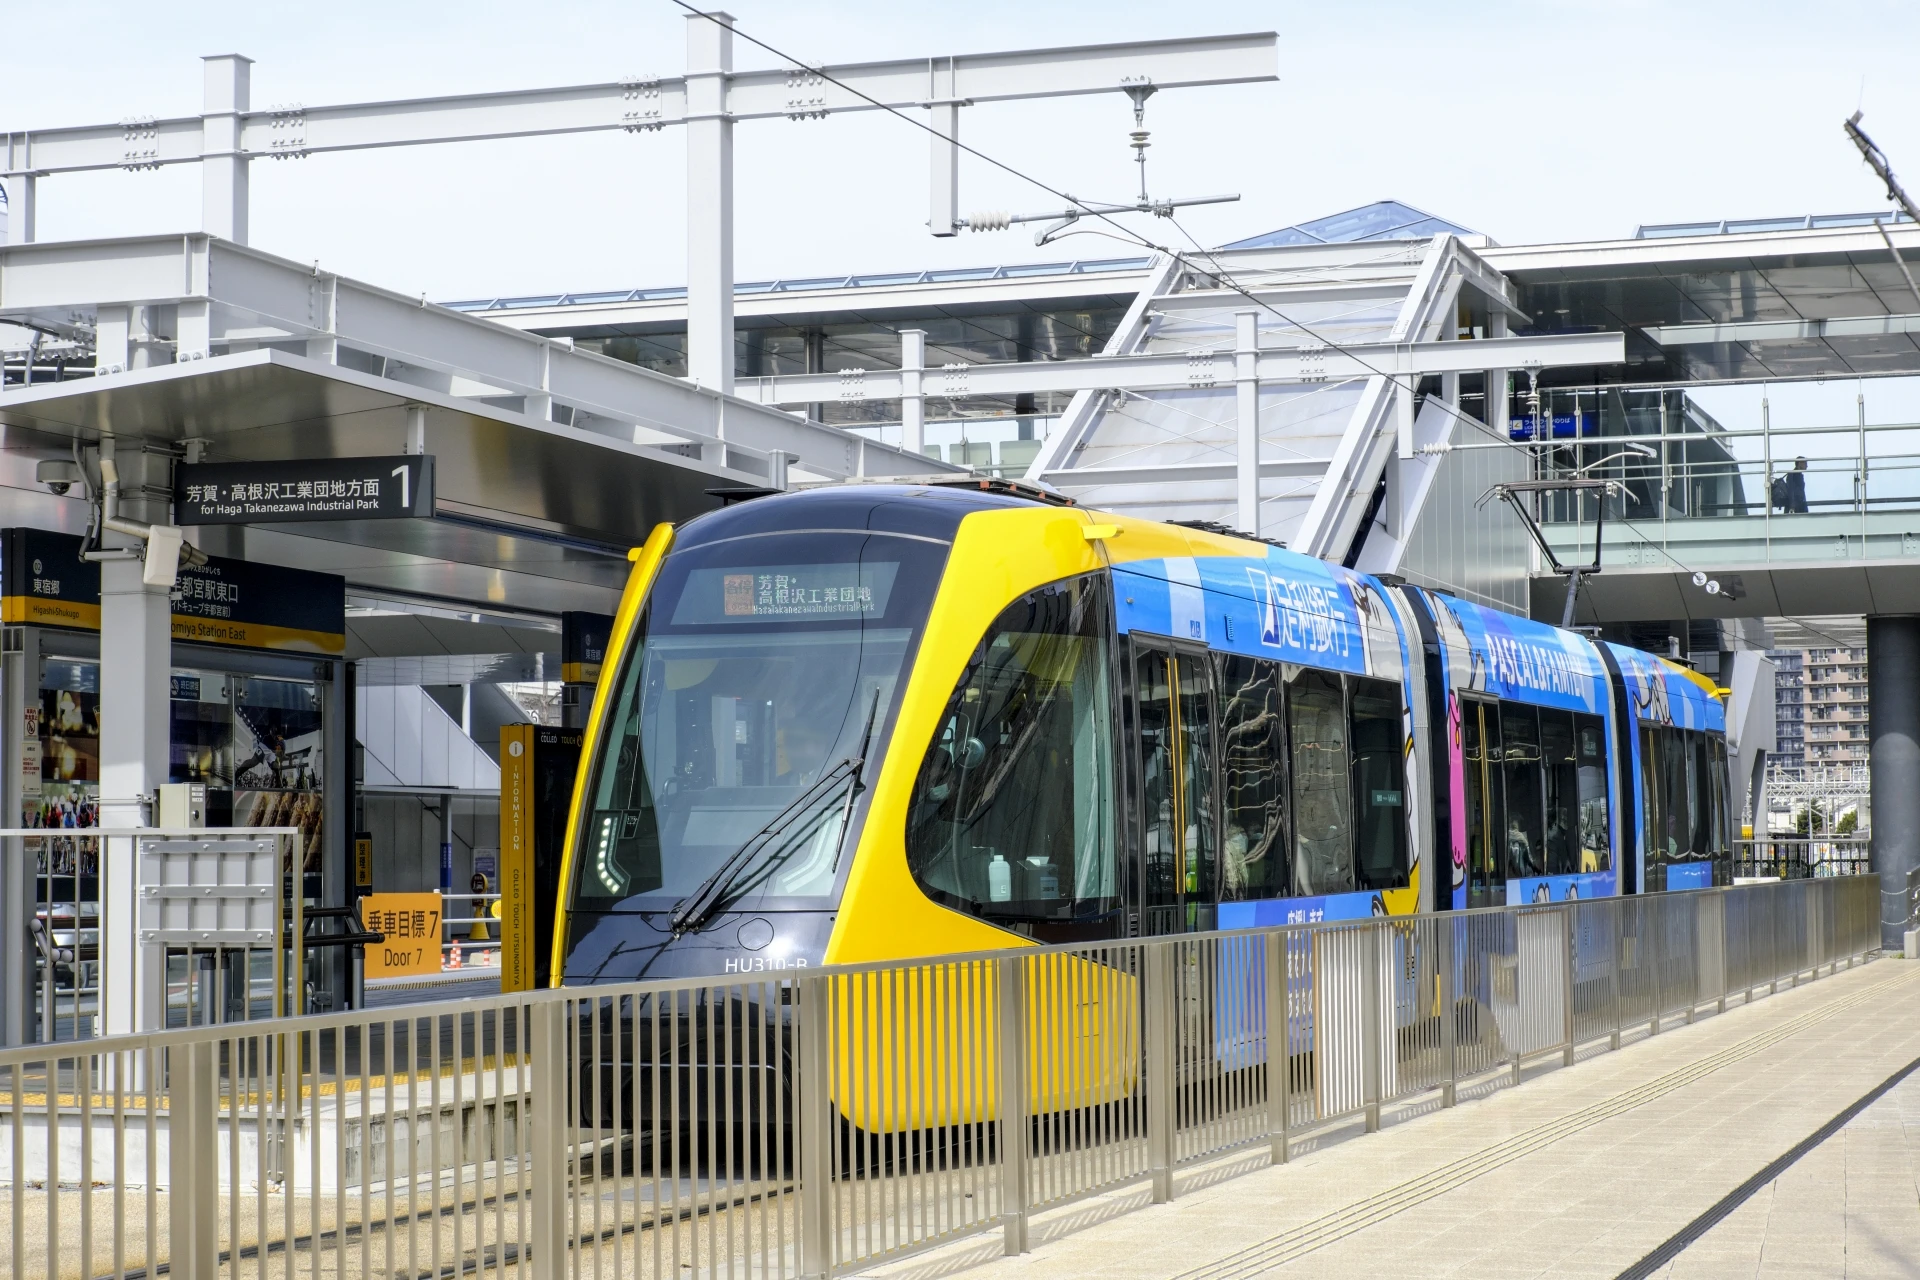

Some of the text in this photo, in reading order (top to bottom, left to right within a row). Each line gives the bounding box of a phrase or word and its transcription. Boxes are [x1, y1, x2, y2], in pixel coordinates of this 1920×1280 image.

[186, 478, 380, 503] 芳賀・高根沢工業団地方面
[391, 464, 409, 508] 1
[200, 498, 379, 516] for Haga Takanezawa Industrial Park
[33, 577, 60, 596] 東宿郷
[758, 586, 872, 605] 高根沢工業団地
[33, 605, 80, 620] Higashi-Shukugo
[170, 620, 246, 641] omiya Station East
[561, 736, 576, 745] TOUCH
[512, 764, 521, 851] INFORMATION
[368, 909, 439, 939] 乗車目標 7
[384, 948, 422, 967] Door 7
